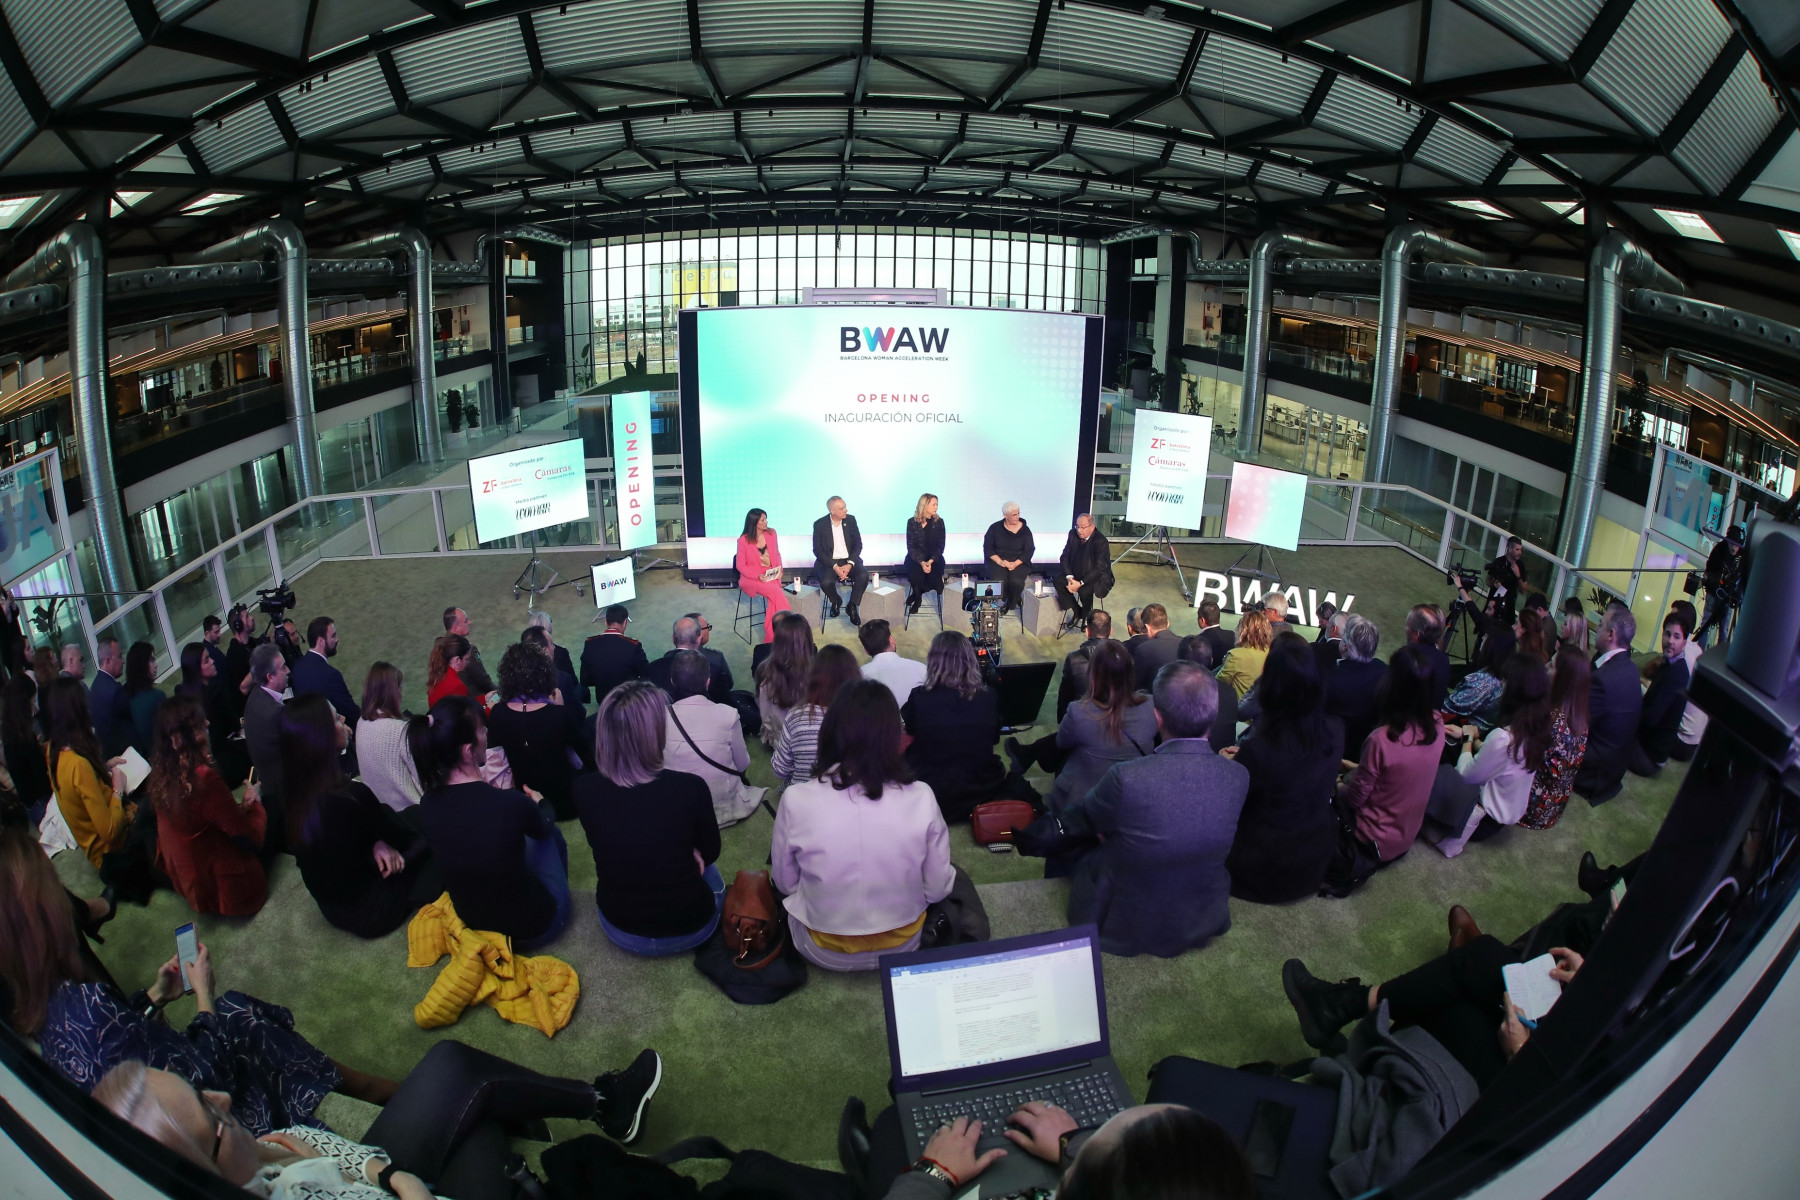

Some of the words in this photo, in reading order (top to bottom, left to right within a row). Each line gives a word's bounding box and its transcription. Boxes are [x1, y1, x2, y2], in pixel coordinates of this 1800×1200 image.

[840, 326, 950, 353] BWAW
[857, 393, 930, 403] OPENING
[824, 411, 912, 423] INAGURACIÓN
[915, 412, 963, 423] OFICIAL
[1150, 437, 1167, 450] ZF
[1148, 455, 1186, 467] Cámaras
[534, 464, 572, 480] Cámaras
[625, 421, 642, 526] OPENING
[482, 479, 498, 494] ZF
[600, 576, 627, 590] BWAW
[1193, 569, 1356, 629] BWAW
